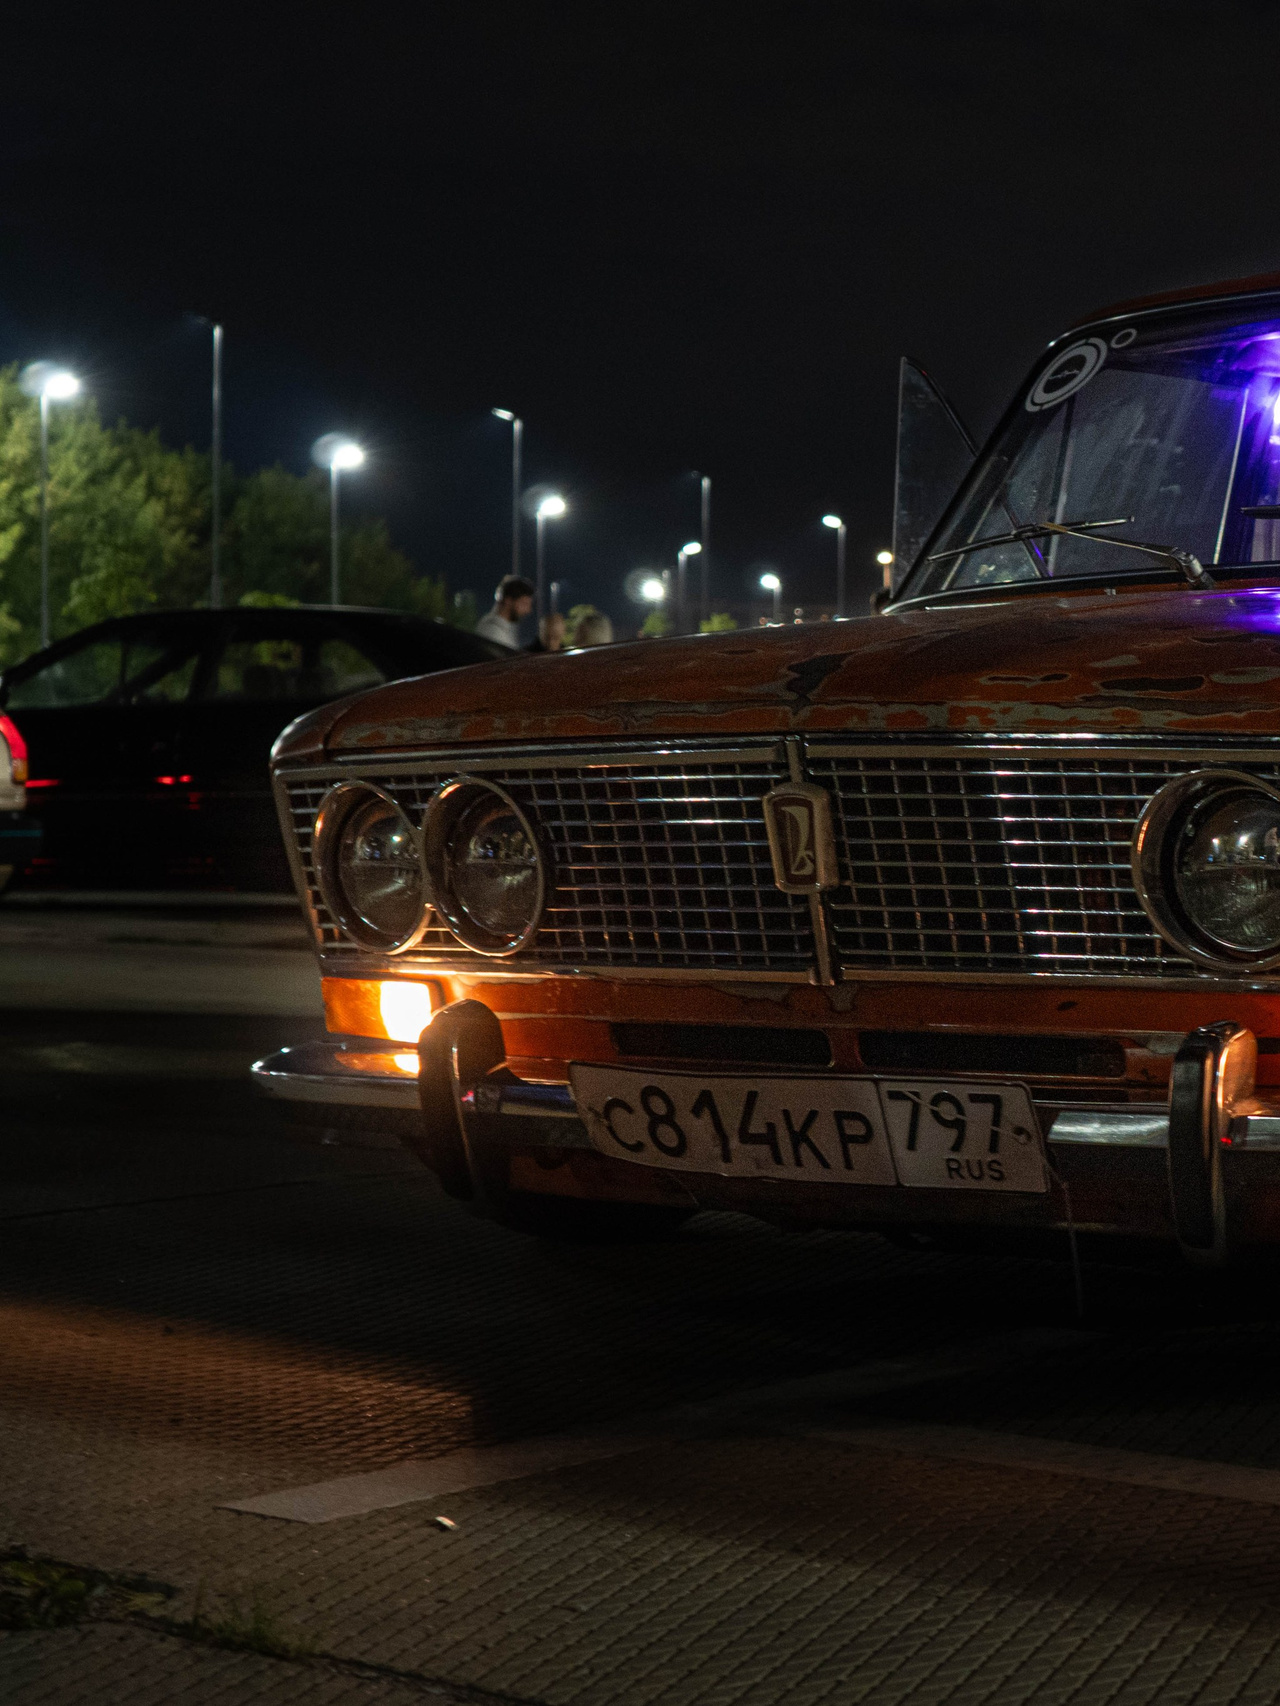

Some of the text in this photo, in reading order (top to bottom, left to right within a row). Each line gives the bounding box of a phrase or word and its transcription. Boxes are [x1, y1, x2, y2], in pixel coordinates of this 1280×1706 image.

[603, 1085, 1003, 1170] C814KP 797
[946, 1158, 1005, 1181] RUS
